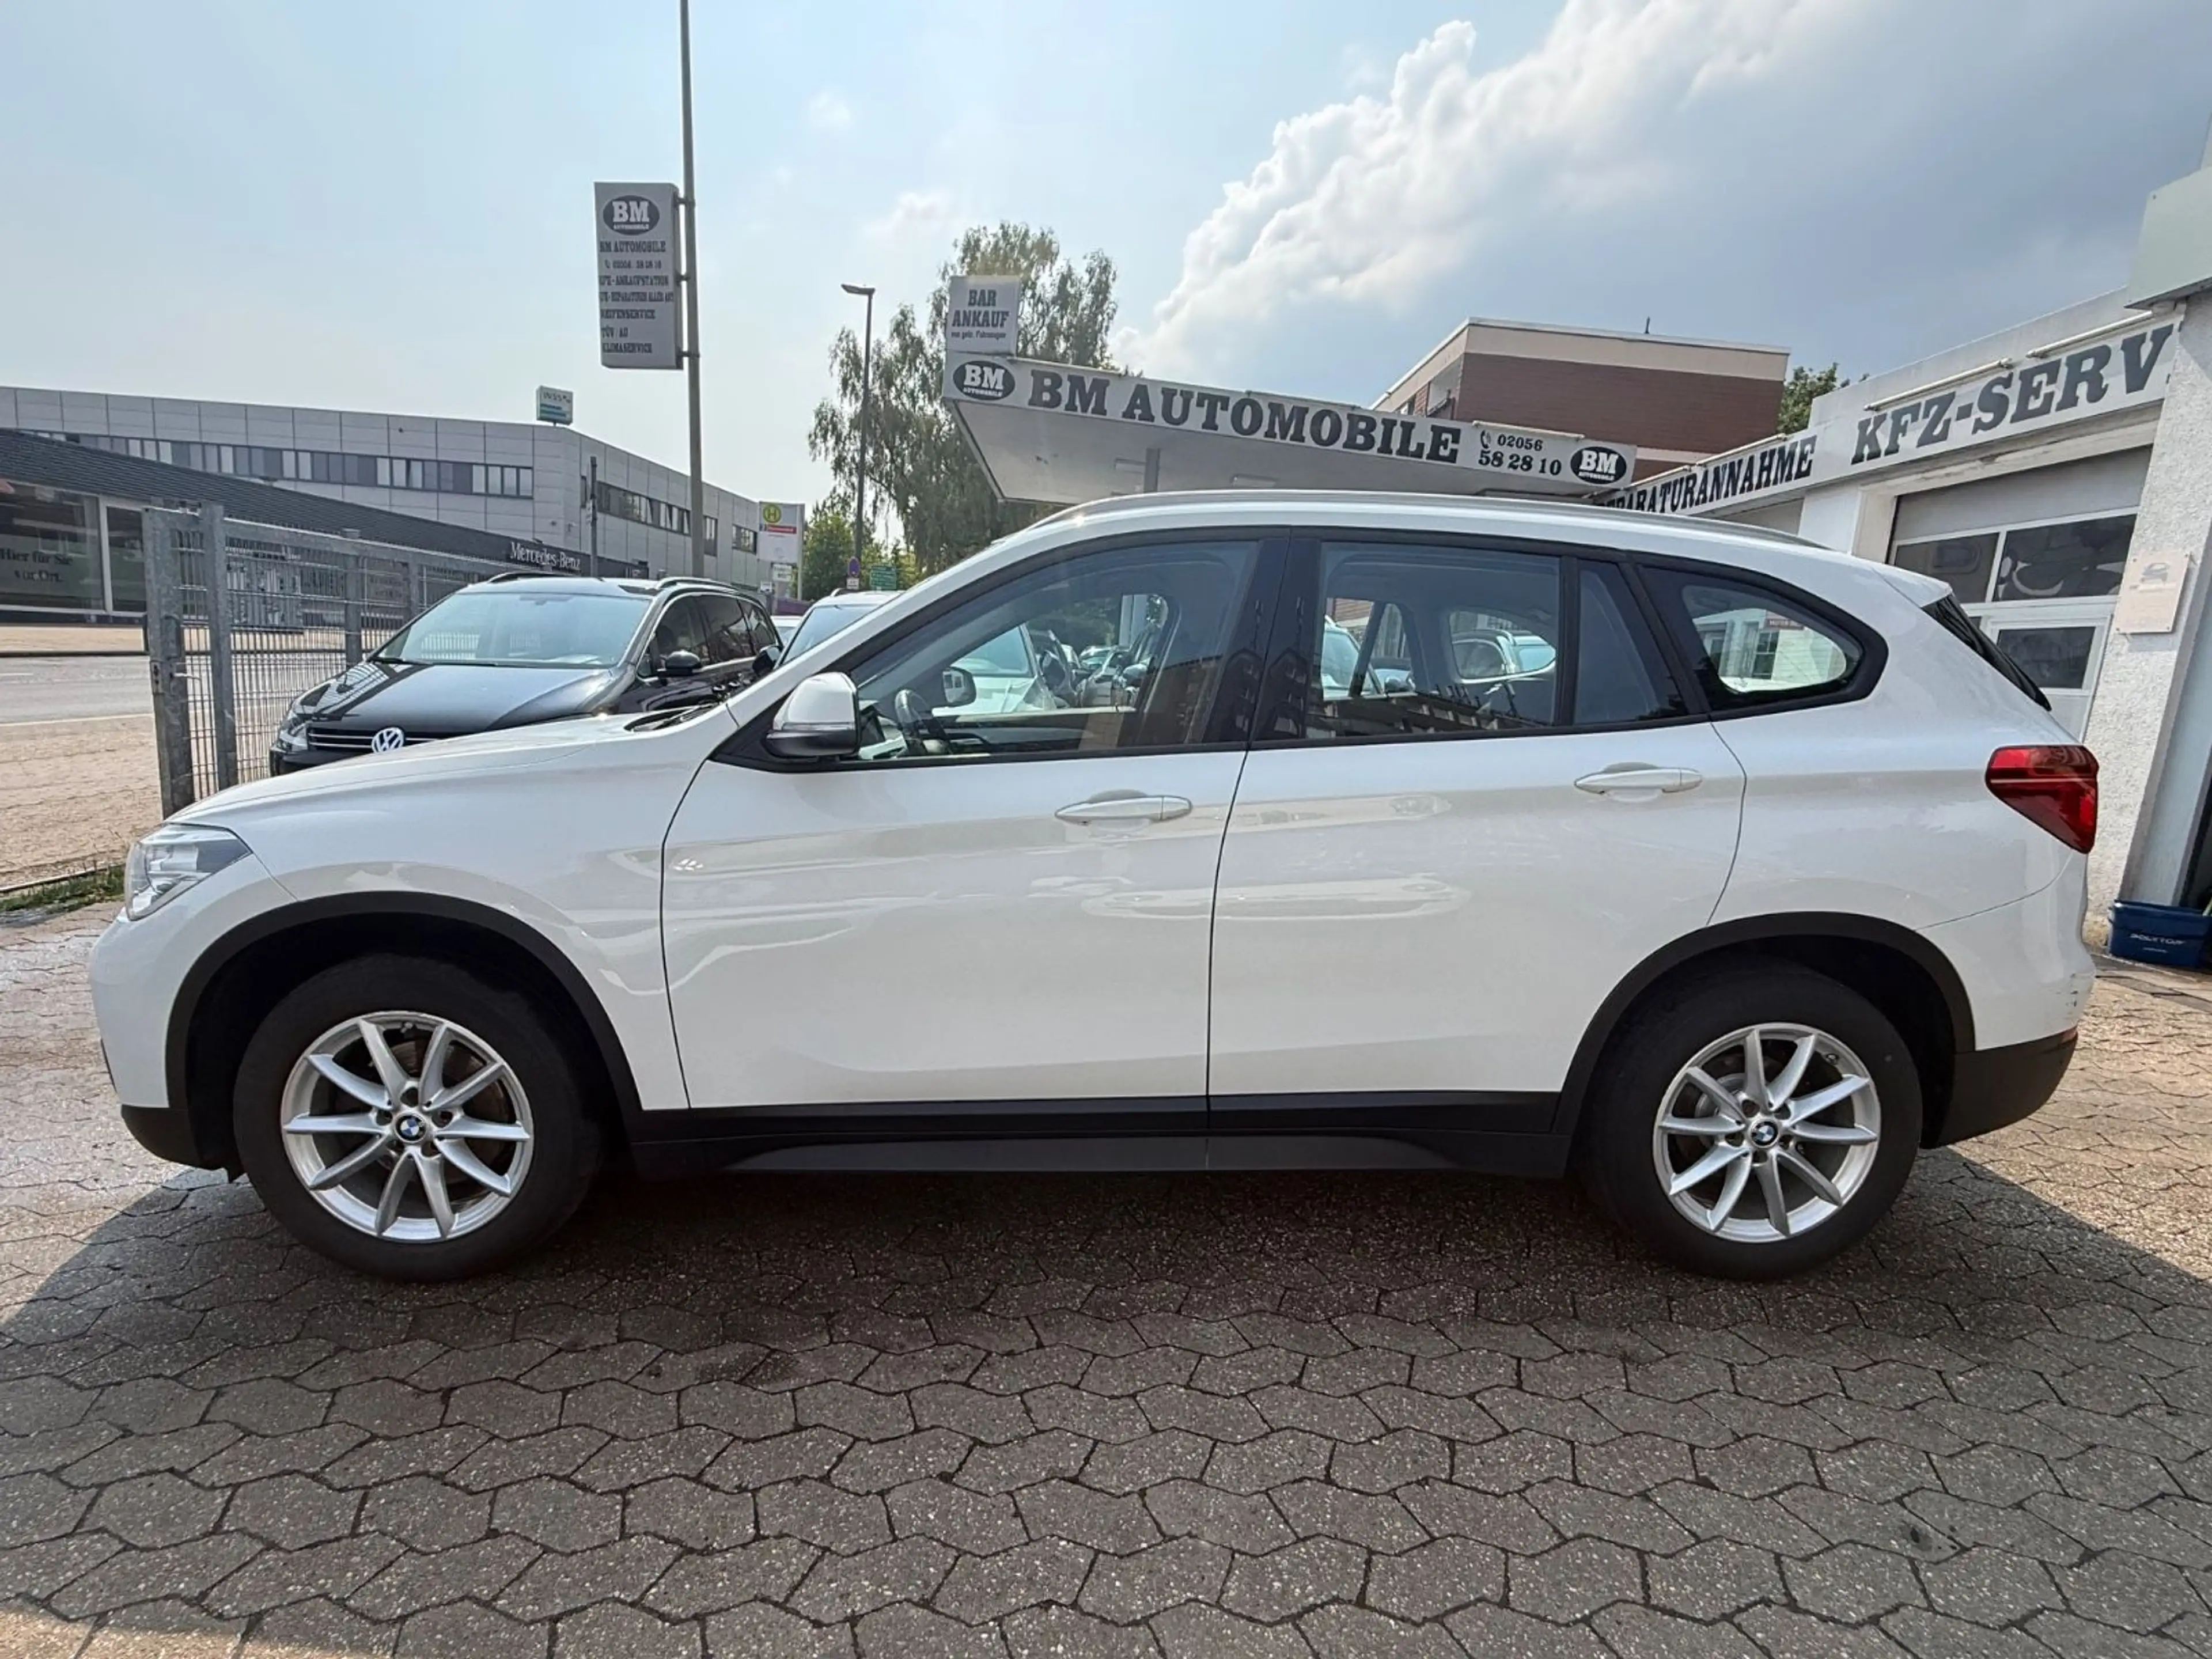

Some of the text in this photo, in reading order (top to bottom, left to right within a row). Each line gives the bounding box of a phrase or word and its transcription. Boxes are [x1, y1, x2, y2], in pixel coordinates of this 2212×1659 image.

[612, 200, 650, 222] BM
[613, 240, 666, 252] AUTOMOBILE
[968, 289, 997, 306] BAR
[952, 309, 1010, 328] ANKAUF
[964, 363, 1005, 390] BM
[1851, 320, 2183, 465] KFZ-SERV
[1028, 369, 1461, 464] BM AUTOMOBILE
[1497, 434, 1543, 452] 02056
[1478, 449, 1562, 476] 58 28 10
[1579, 450, 1619, 474] BM
[510, 541, 581, 571] Mercedes-Benz
